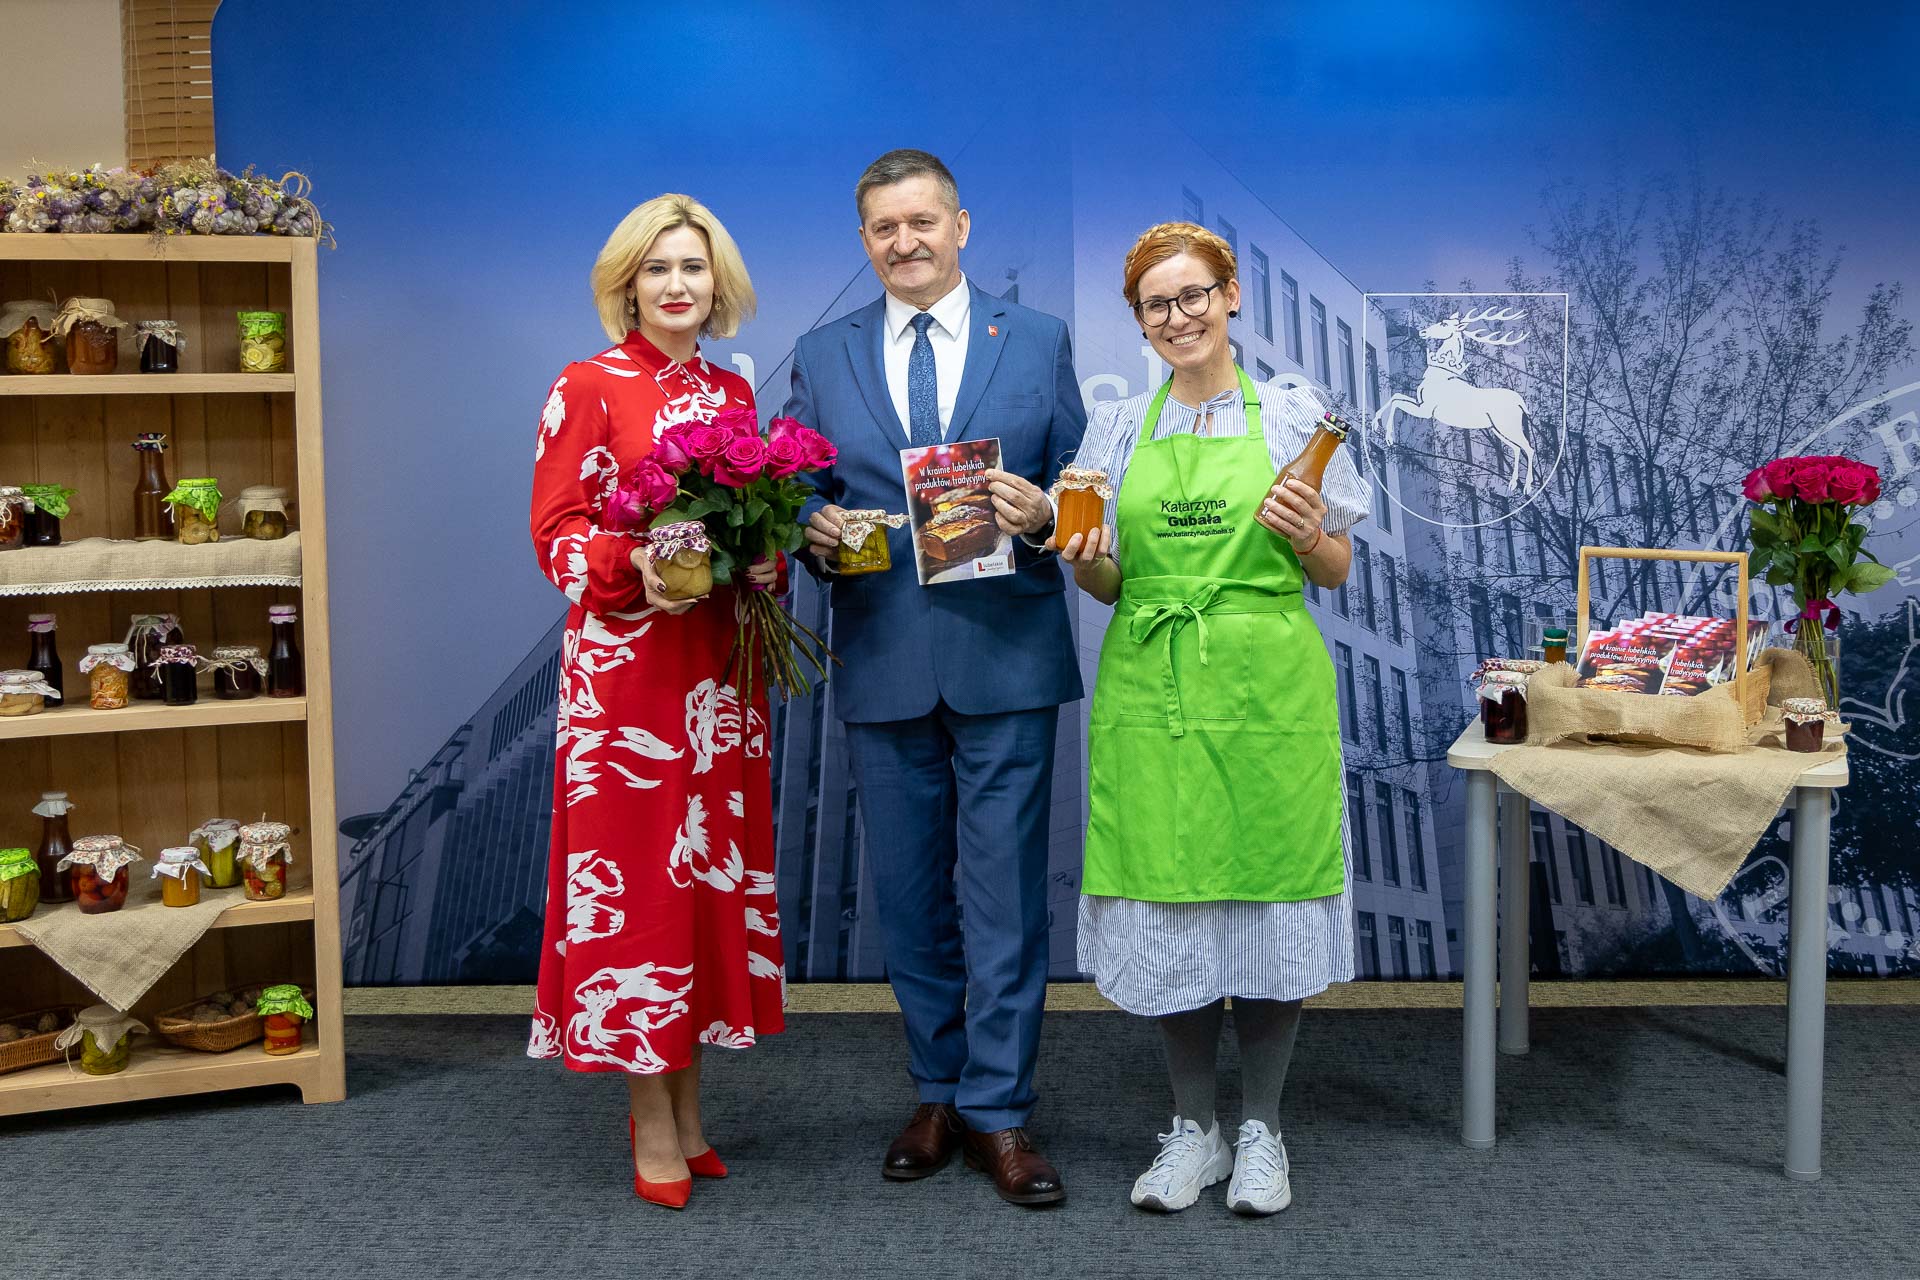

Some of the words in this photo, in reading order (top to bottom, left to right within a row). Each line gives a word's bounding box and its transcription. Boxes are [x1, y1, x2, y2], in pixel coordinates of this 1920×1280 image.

[919, 467, 925, 477] W
[927, 465, 951, 476] krainie
[952, 459, 985, 473] lubelskich
[915, 477, 951, 492] produktów
[952, 474, 988, 486] tradycyjny
[1161, 500, 1227, 513] Katarzyna
[1168, 514, 1222, 527] Gubała
[1606, 644, 1627, 653] krainie
[1628, 646, 1657, 656] lubelskich
[1675, 659, 1704, 669] lubelskich
